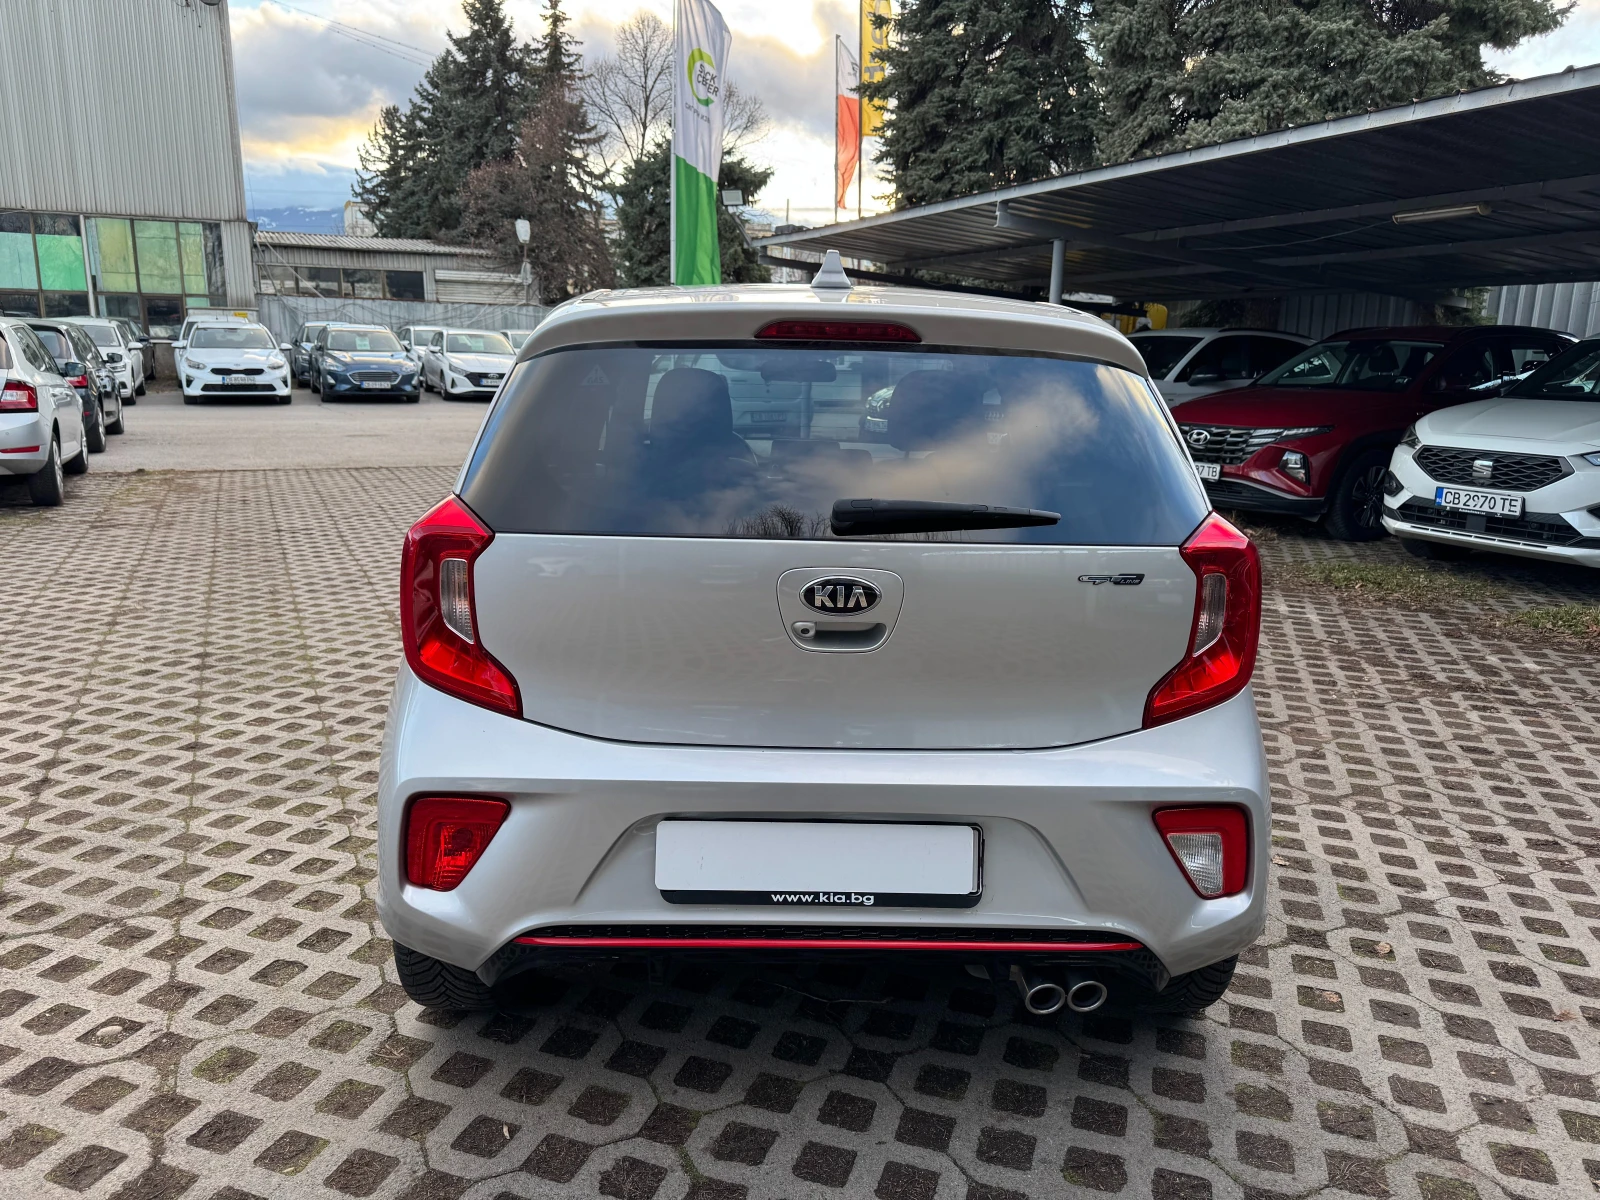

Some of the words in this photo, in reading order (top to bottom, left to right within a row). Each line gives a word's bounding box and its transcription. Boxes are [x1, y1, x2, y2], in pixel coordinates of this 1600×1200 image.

[1207, 466, 1218, 477] TB
[1444, 491, 1461, 505] CB
[1462, 493, 1497, 510] 2970
[1500, 497, 1519, 513] TE
[814, 586, 868, 608] KIA
[771, 892, 875, 905] www.kia.bg
